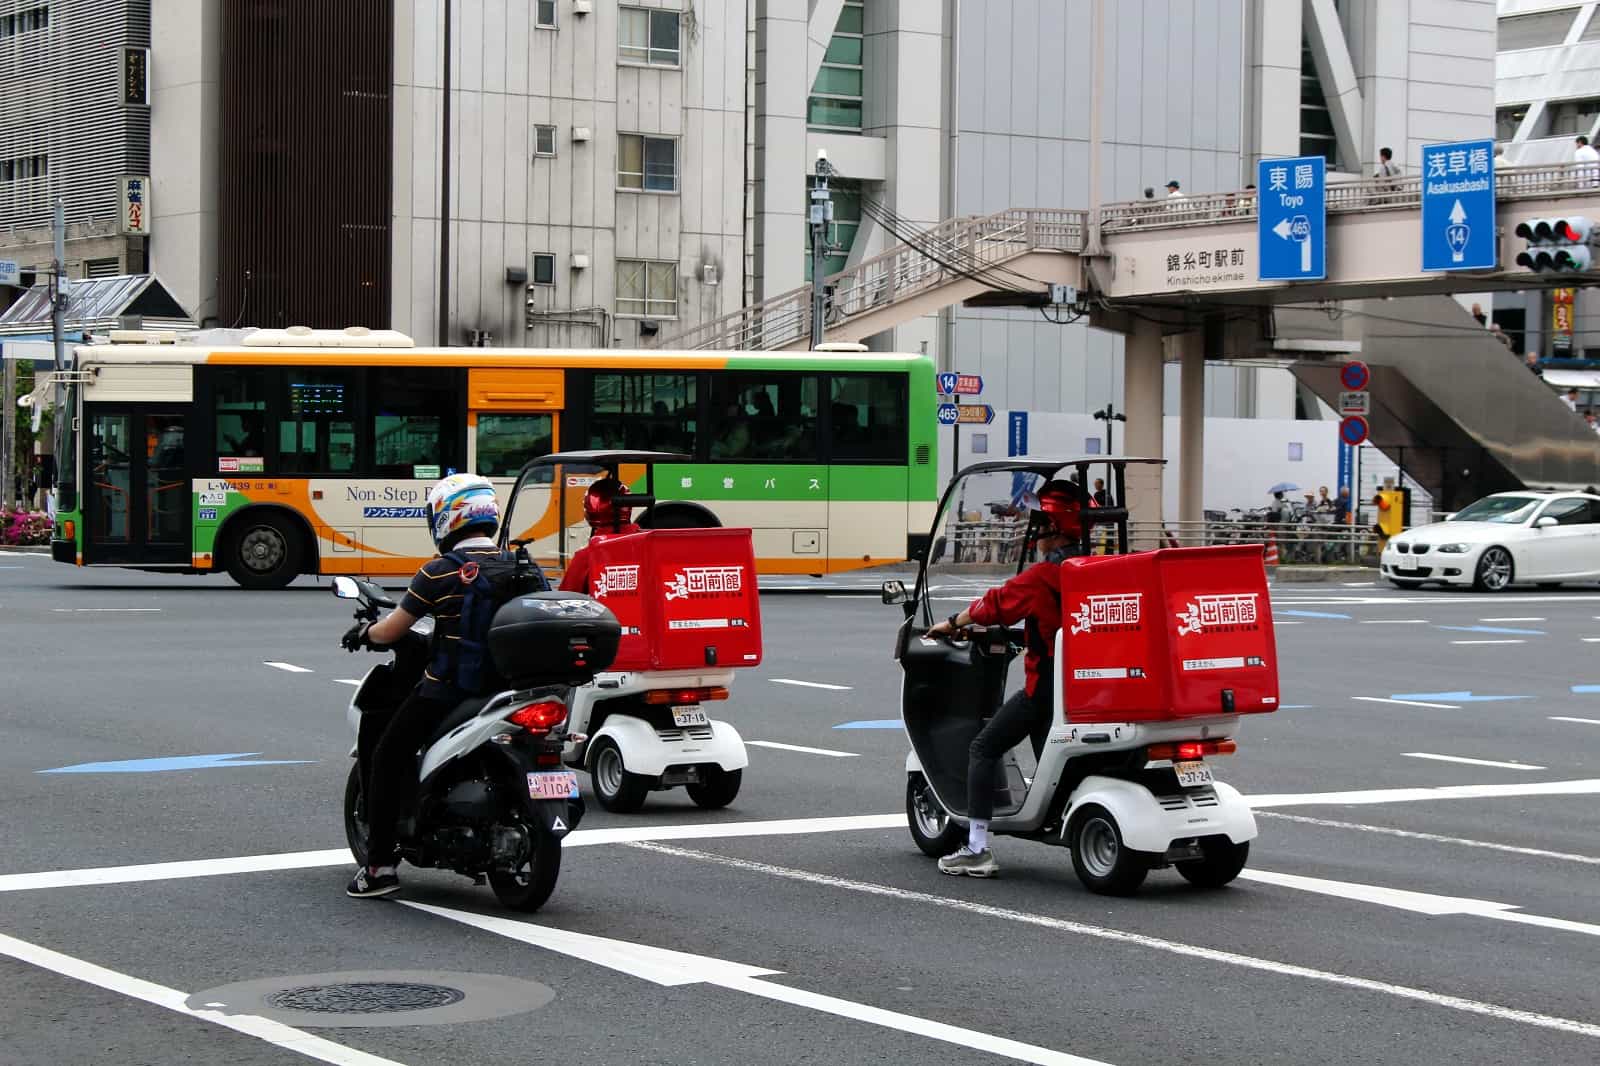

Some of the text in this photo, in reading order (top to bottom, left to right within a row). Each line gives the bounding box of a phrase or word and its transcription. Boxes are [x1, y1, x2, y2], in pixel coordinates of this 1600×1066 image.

[1427, 149, 1488, 178] 浅草橋
[1269, 164, 1313, 191] 東陽
[1427, 176, 1490, 195] Asakusabashi
[1279, 193, 1304, 209] Toyo
[1293, 222, 1309, 236] 465
[1450, 228, 1465, 245] 14
[1167, 248, 1245, 272] 錦糸町駅前
[943, 375, 955, 390] 14
[938, 407, 957, 421] 465
[365, 507, 428, 517] ノンステップバ
[689, 573, 740, 591] 出前館
[1092, 602, 1138, 622] 出前館
[1202, 602, 1255, 623] 出前館
[1185, 771, 1212, 782] 37-24
[543, 783, 571, 796] 1104
